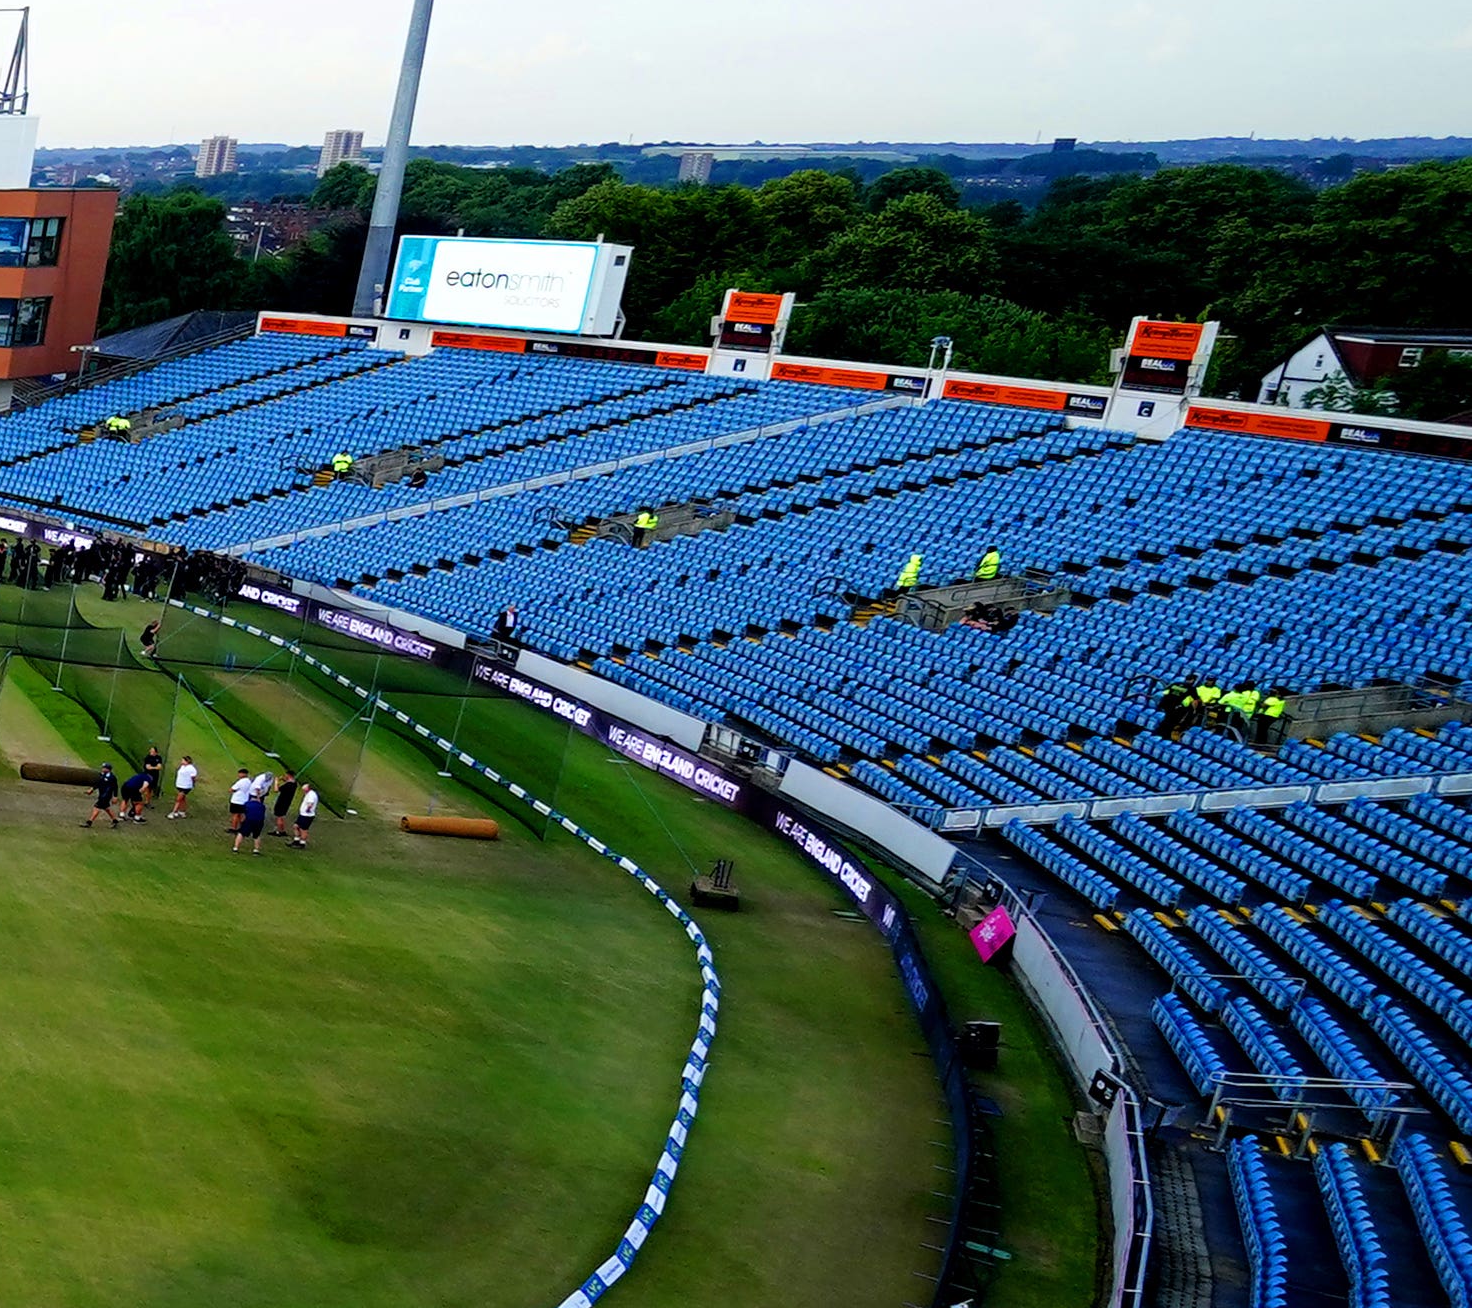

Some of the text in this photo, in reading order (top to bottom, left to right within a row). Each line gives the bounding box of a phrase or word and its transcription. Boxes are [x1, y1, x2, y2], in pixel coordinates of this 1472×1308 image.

[318, 607, 437, 660] WE ARE ENGLAND CRICKET
[608, 725, 740, 803] WE ARE ENGLAND CRICKET
